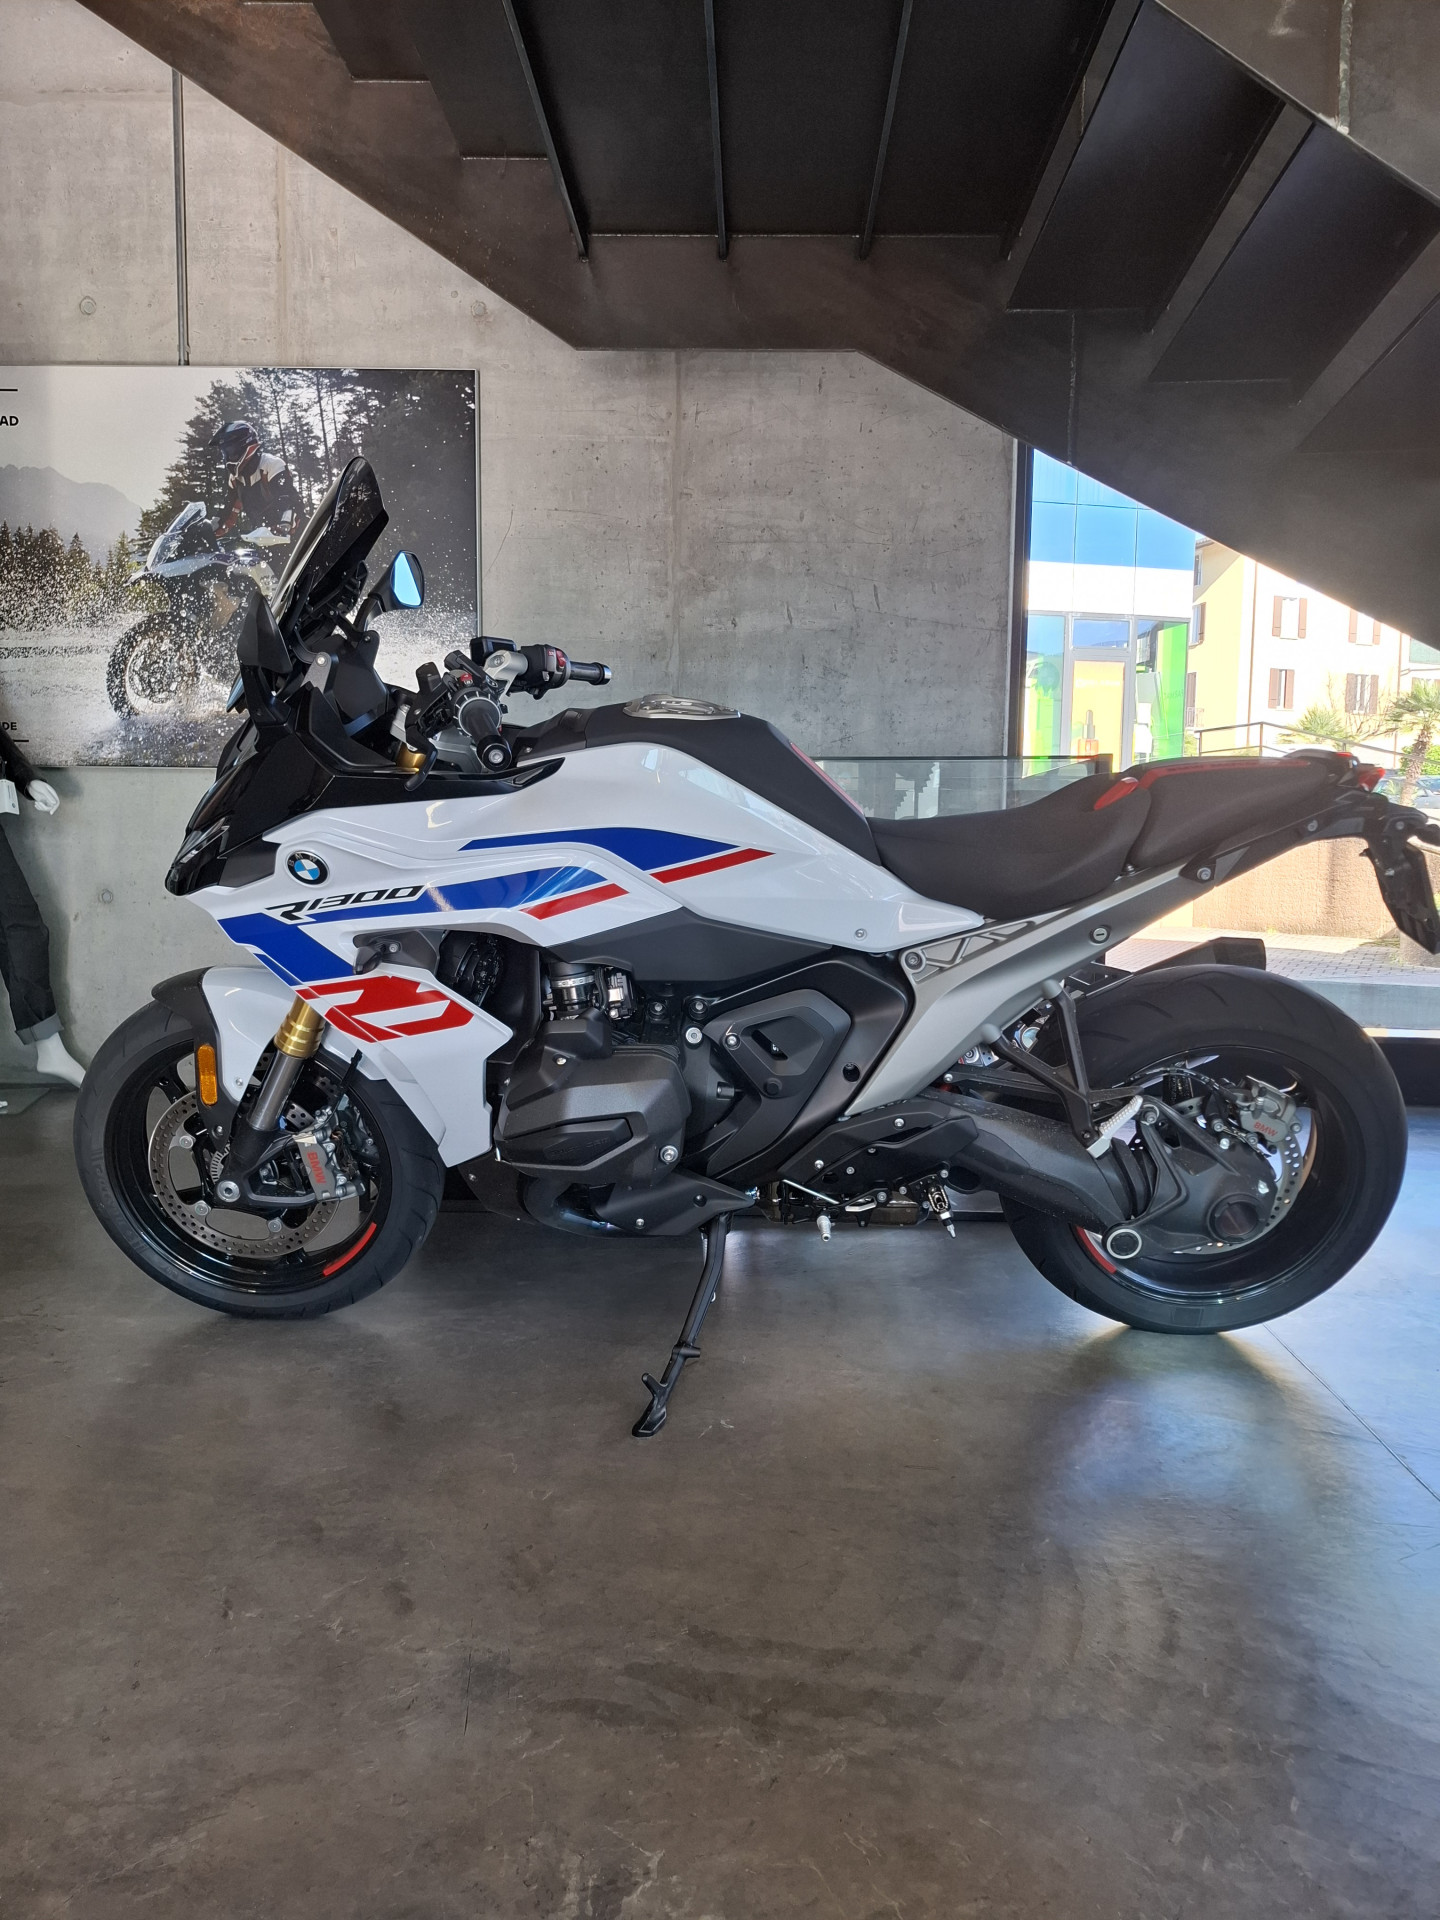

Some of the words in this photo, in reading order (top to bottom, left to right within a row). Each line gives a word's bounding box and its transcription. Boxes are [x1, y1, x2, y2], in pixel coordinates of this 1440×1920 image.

[0, 722, 17, 731] DE
[1254, 1121, 1278, 1137] BMW
[307, 1151, 327, 1185] BMW
